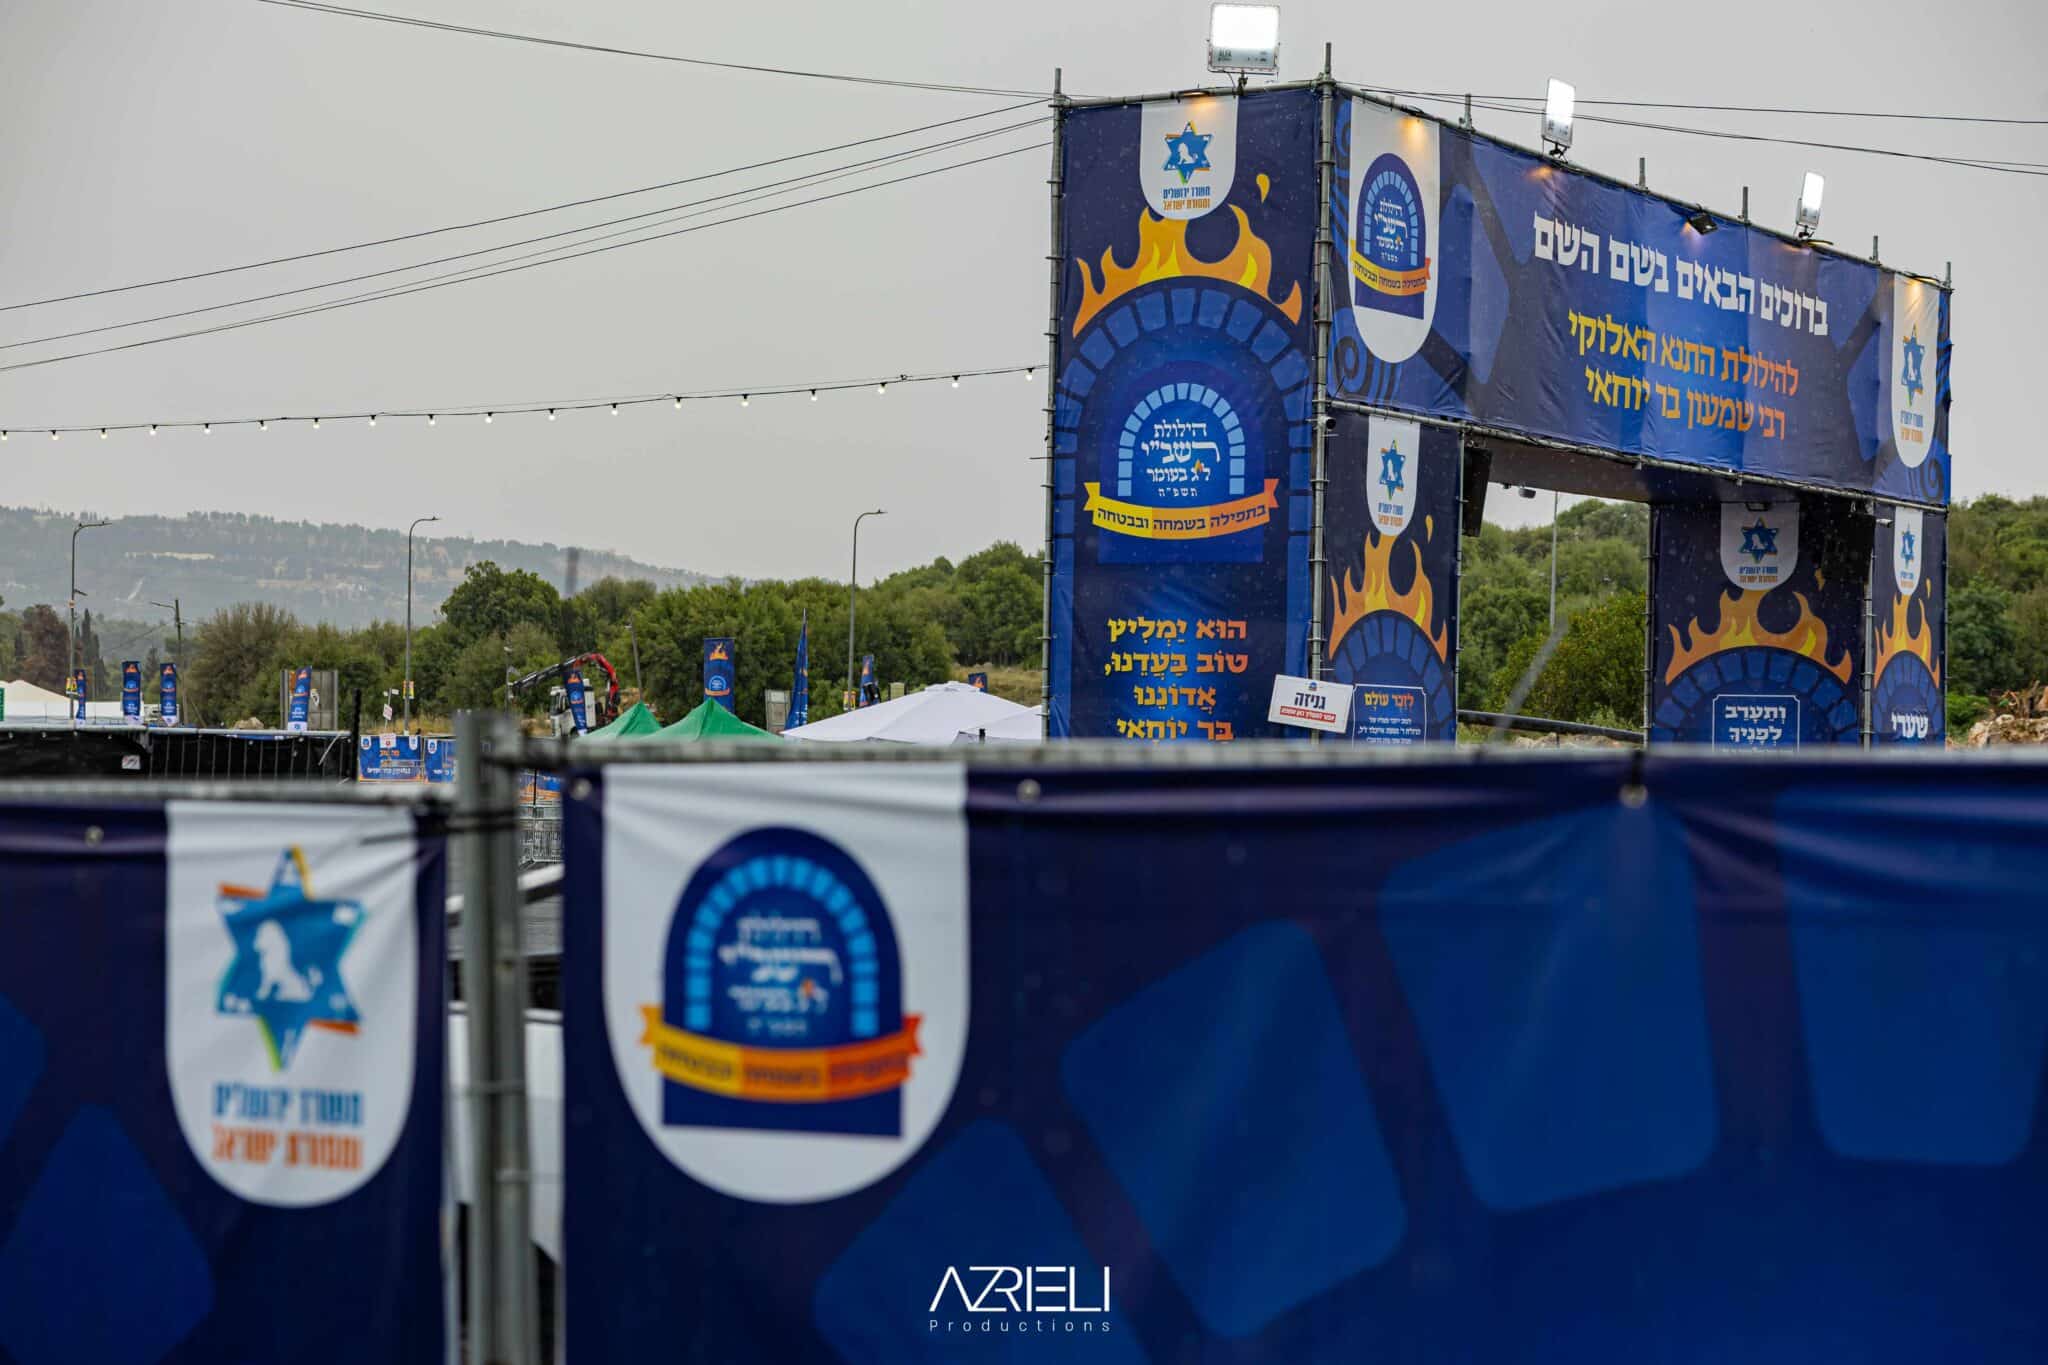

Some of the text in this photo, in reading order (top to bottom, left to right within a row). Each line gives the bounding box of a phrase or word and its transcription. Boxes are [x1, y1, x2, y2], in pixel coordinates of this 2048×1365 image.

[1533, 210, 1829, 336] ברוכים הבאים בשם השם
[1568, 308, 1799, 396] להילולת התנא האלוקי
[1585, 364, 1785, 441] רבי שמעון בר יוחאי
[1154, 419, 1207, 438] הילולת
[1146, 467, 1188, 482] בעומר
[1097, 504, 1267, 531] בתפילה בשמחה ובבטחה
[1294, 692, 1326, 710] גניזה
